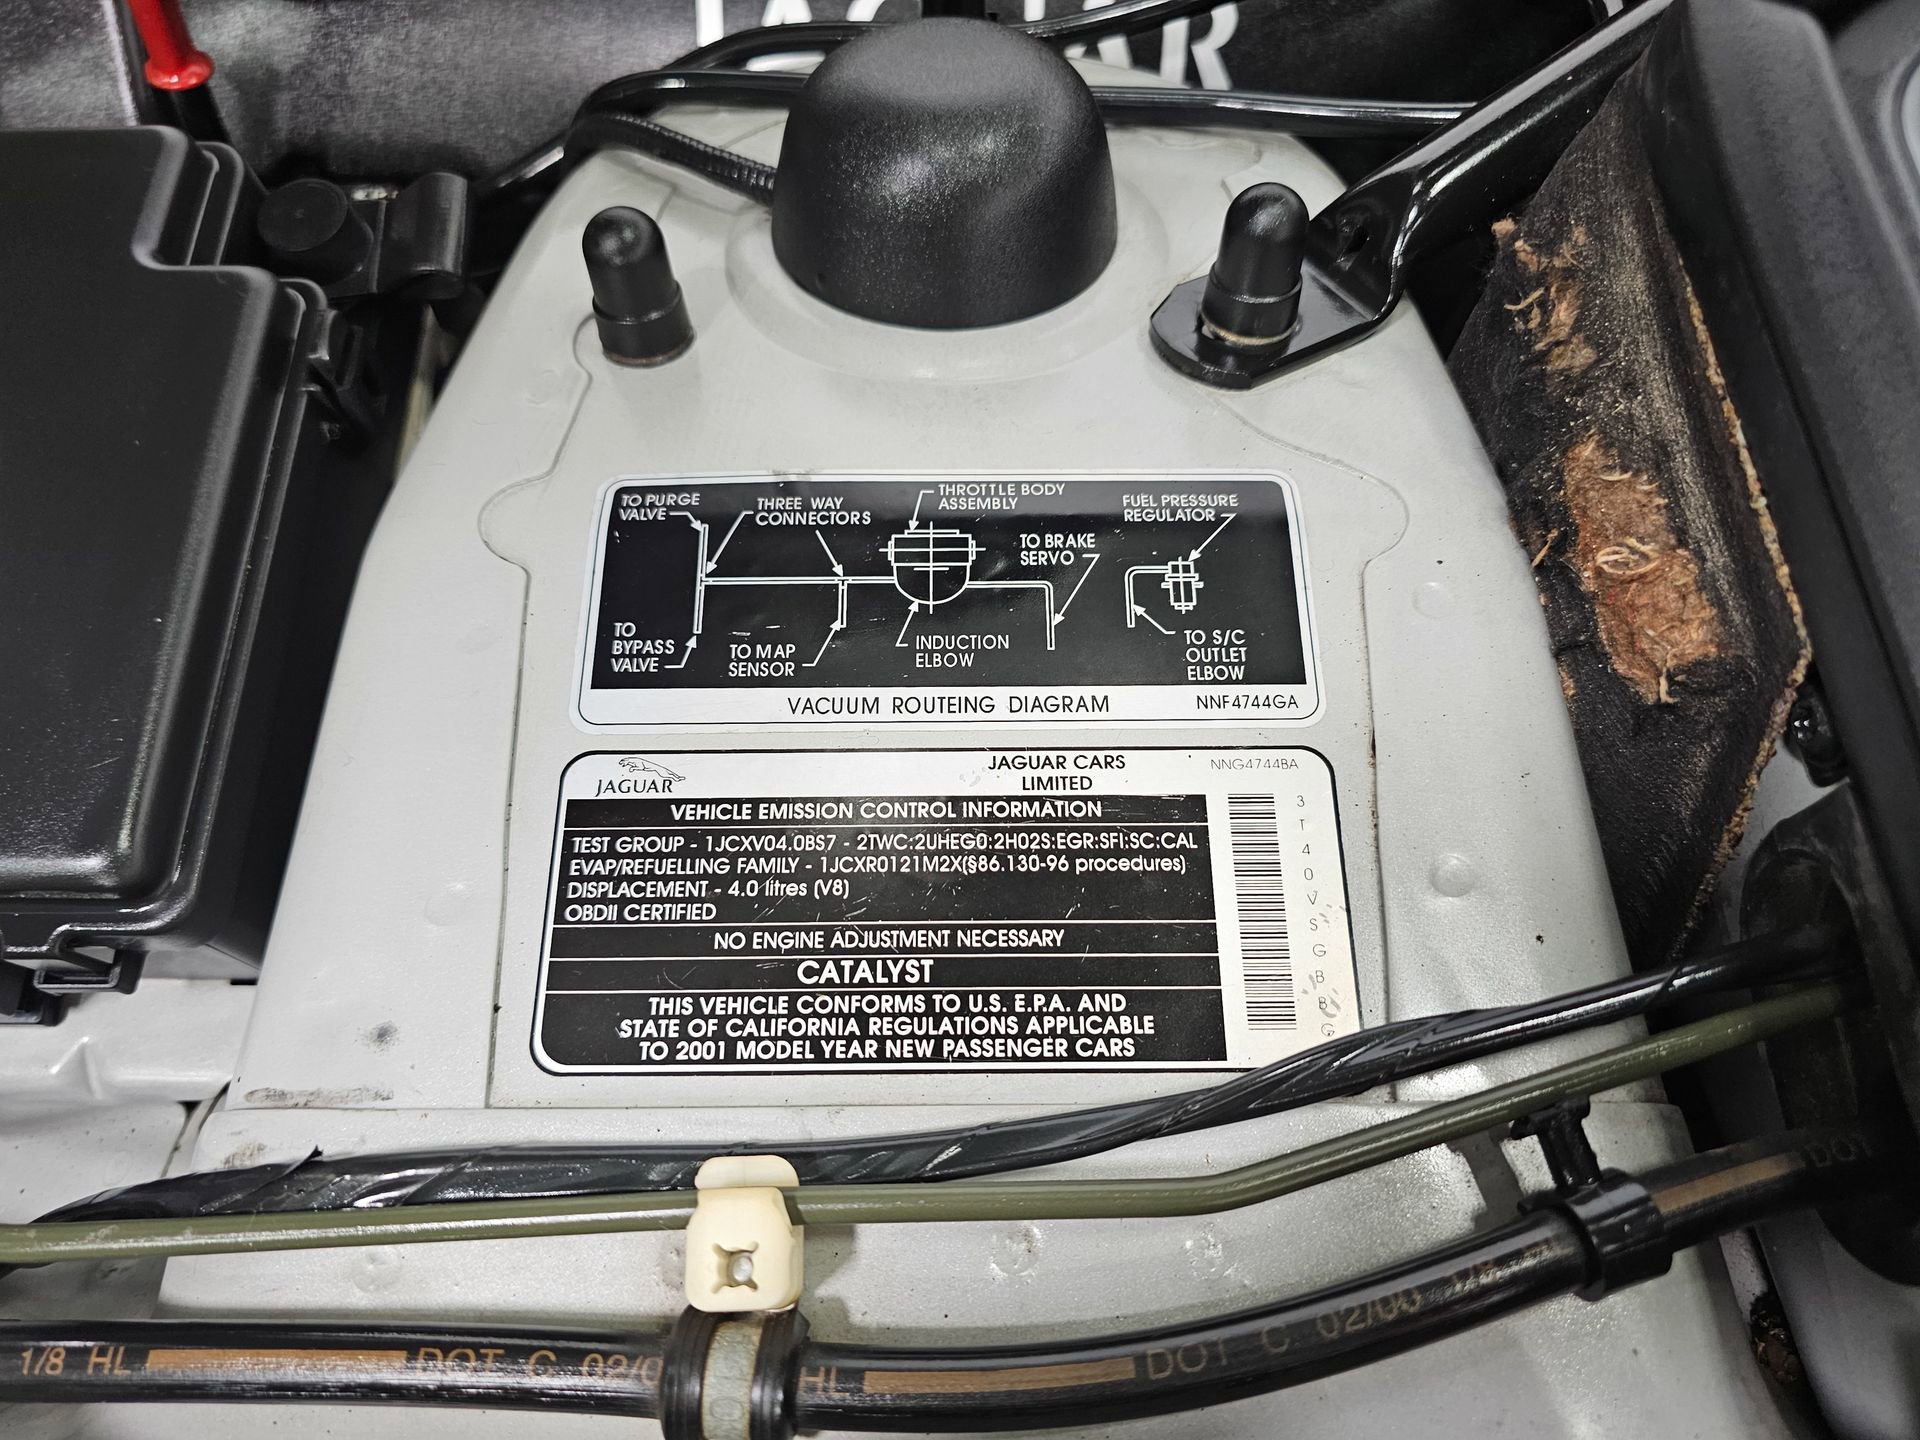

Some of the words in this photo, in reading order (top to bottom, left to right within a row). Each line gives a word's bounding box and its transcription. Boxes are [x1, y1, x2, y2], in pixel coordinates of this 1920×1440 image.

[938, 483, 1017, 496] THROTTLE
[1020, 482, 1066, 496] BODY
[621, 495, 643, 507] TO
[645, 493, 700, 507] PURGE
[757, 497, 803, 510] THREE
[811, 497, 844, 510] WAY
[938, 497, 1018, 511] ASSEMBLY
[1122, 494, 1158, 507] FUEL
[1160, 494, 1239, 507] PRESSURE
[619, 508, 667, 521] VALVE
[755, 511, 872, 526] CONNECTORS
[1123, 508, 1216, 522] REGULATOR
[1019, 534, 1041, 549] TO
[1044, 533, 1096, 549] BRAKE
[1019, 551, 1075, 566] SERVO
[613, 622, 637, 637] TO
[1184, 629, 1208, 645] TO
[1211, 629, 1246, 645] S/C
[612, 639, 676, 656] BYPASS
[916, 635, 1009, 650] INDUCTION
[729, 644, 753, 659] TO
[756, 644, 796, 660] MAP
[916, 652, 975, 668] ELBOW
[1184, 647, 1247, 663] OUTLET
[610, 658, 660, 673] VALVE
[728, 662, 796, 678] SENSOR
[1187, 665, 1245, 682] ELBOW
[787, 697, 880, 715] VACUUM
[891, 696, 996, 715] ROUTEING
[1008, 695, 1110, 714] DIAGRAM
[1196, 694, 1299, 710] NNF4744GA
[988, 755, 1067, 770] JAGUAR
[1073, 754, 1126, 770] CARS
[1210, 758, 1299, 771] NNG4744BA
[595, 779, 674, 798] JAGUAR
[1022, 776, 1093, 791] LIMITED
[670, 803, 752, 821] VEHICLE
[758, 802, 853, 820] EMISSION
[860, 801, 957, 819] CONTROL
[962, 800, 1102, 818] INFORMATION
[572, 837, 611, 853] TEST
[615, 836, 685, 853] GROUP
[569, 857, 731, 877] EVAP/REFUELLING
[736, 856, 801, 875] FAMILY
[1075, 854, 1187, 876] procedures)
[567, 880, 710, 899] DISPLACEMENT
[728, 880, 760, 898] 4.0
[764, 879, 808, 898] litres
[814, 879, 851, 900] (V8)
[564, 904, 618, 922] OBDII
[624, 903, 717, 921] CERTIFIED
[713, 932, 747, 950] NO
[752, 931, 824, 950] ENGINE
[830, 930, 949, 949] ADJUSTMENT
[957, 929, 1065, 948] NECESSARY
[796, 959, 934, 984] CATALYST
[649, 996, 694, 1016] THIS
[699, 995, 790, 1015] VEHICLE
[796, 994, 926, 1015] CONFORMS
[932, 994, 962, 1013] TO
[968, 994, 1010, 1013] U.S.
[1014, 994, 1071, 1013] E.P.A.
[1077, 993, 1127, 1012] AND
[618, 1019, 680, 1038] STATE
[687, 1019, 719, 1038] OF
[725, 1018, 861, 1037] CALIFORNIA
[868, 1016, 1019, 1036] REGULATIONS
[1025, 1015, 1155, 1035] APPLICABLE
[638, 1042, 669, 1061] TO
[675, 1041, 726, 1060] 2001
[735, 1040, 815, 1060] MODEL
[820, 1040, 876, 1059] YEAR
[880, 1039, 935, 1058] NEW
[942, 1038, 1069, 1058] PASSENGER
[1074, 1037, 1136, 1057] CARS
[21, 1345, 66, 1376] 1/8
[86, 1344, 132, 1376] HL
[528, 1349, 557, 1379] C
